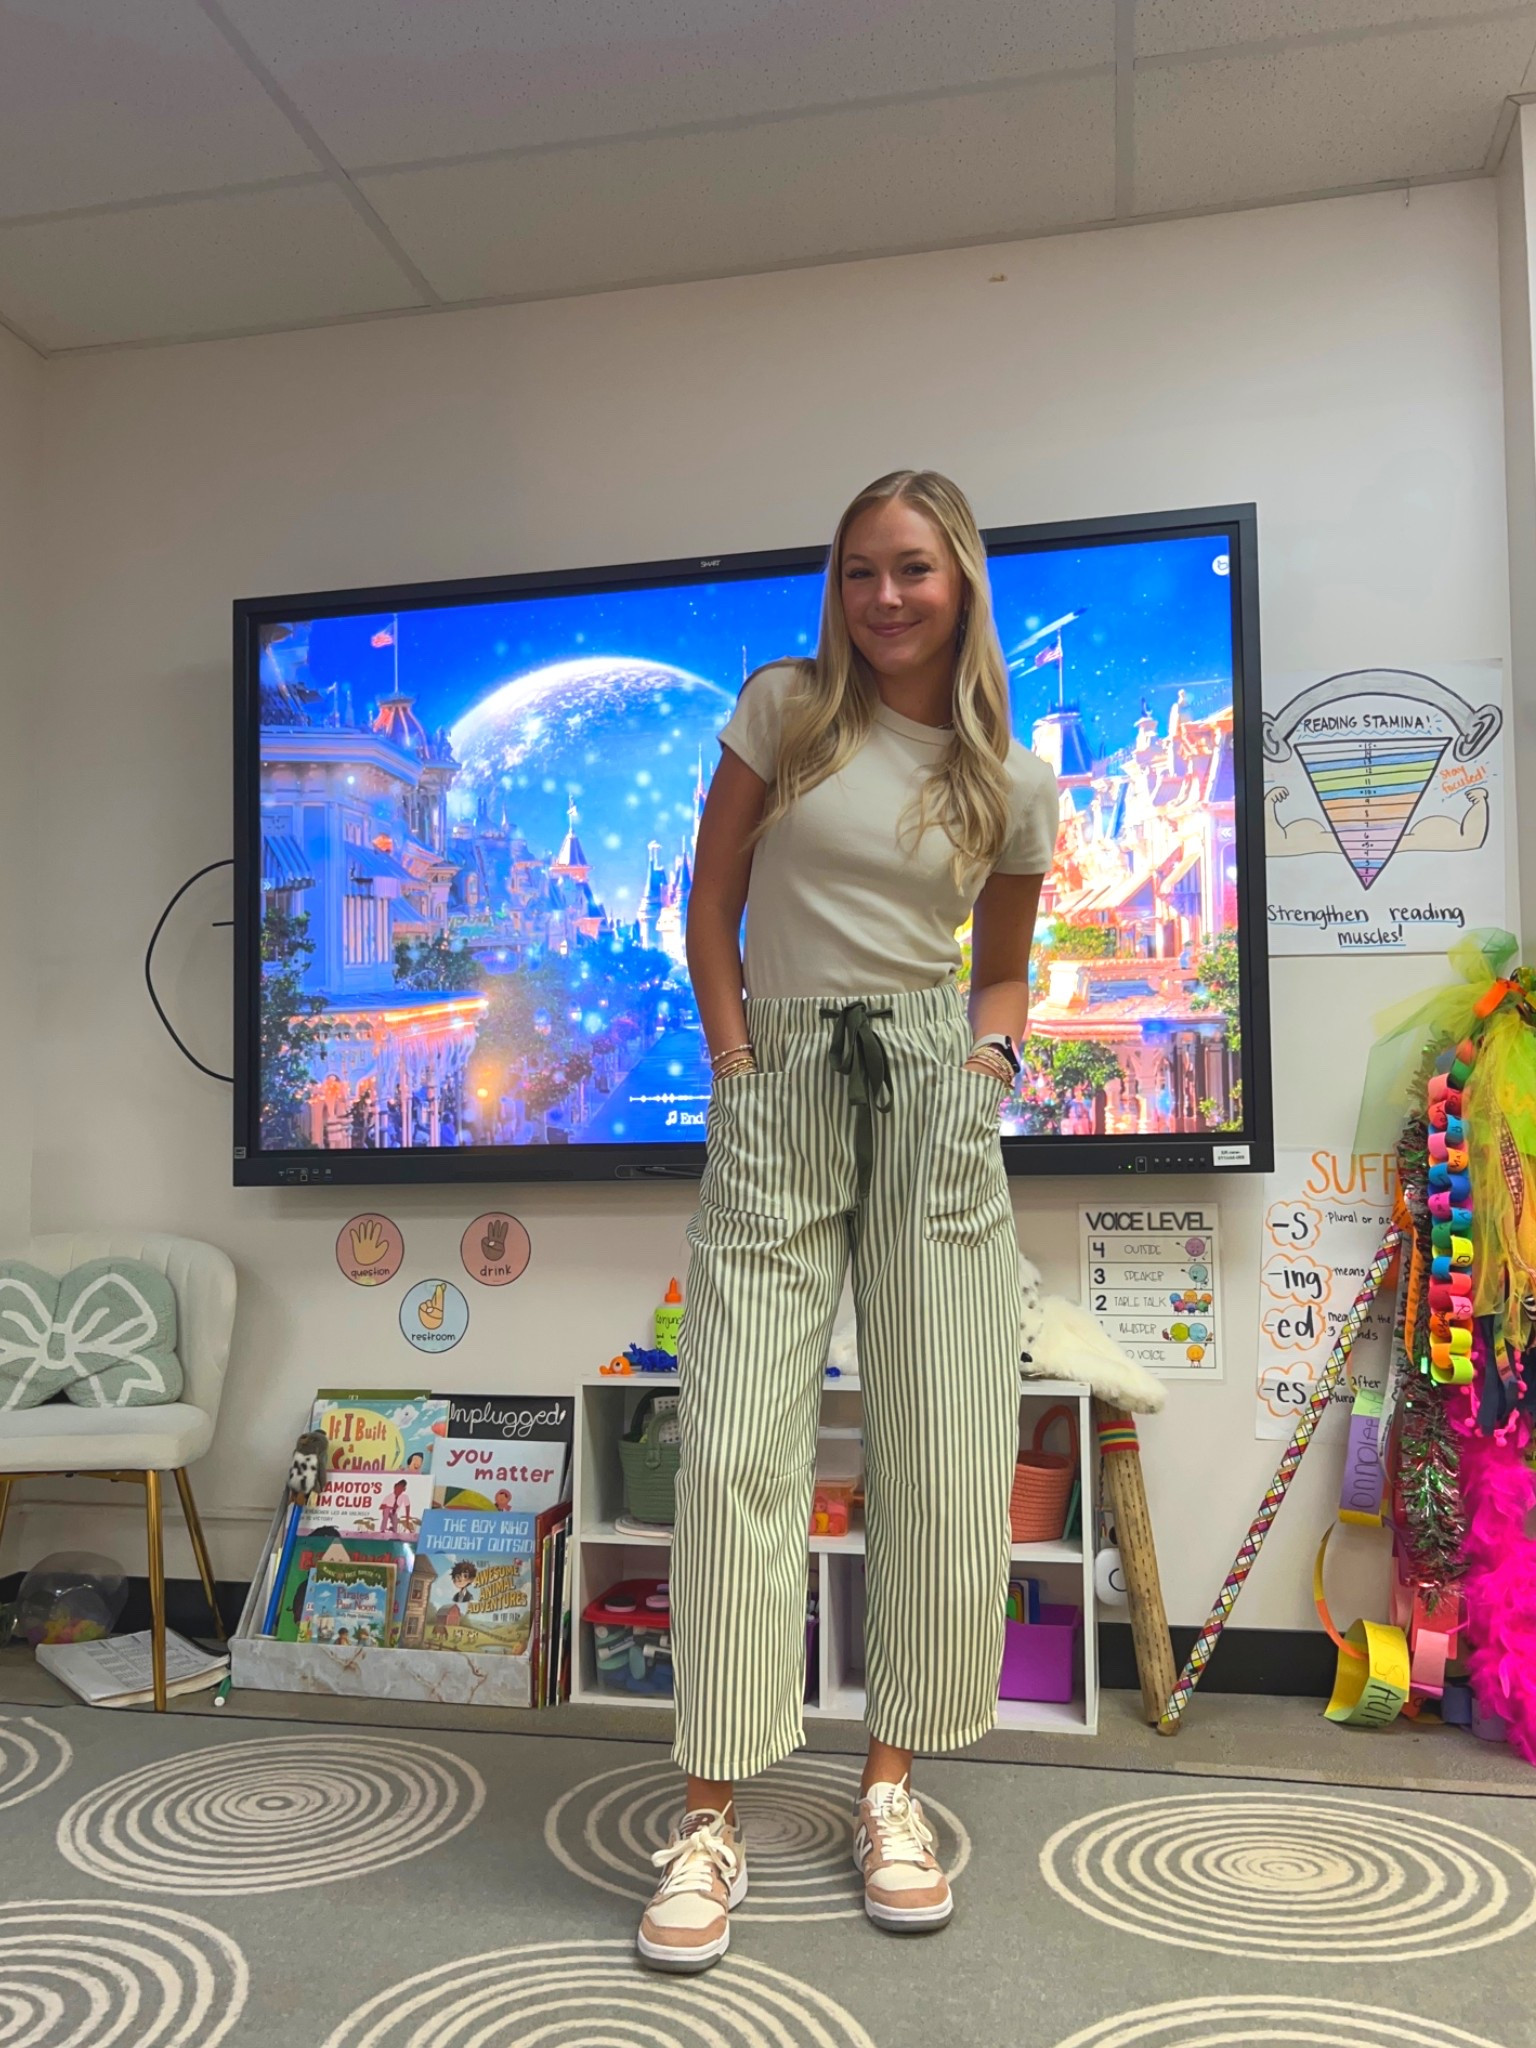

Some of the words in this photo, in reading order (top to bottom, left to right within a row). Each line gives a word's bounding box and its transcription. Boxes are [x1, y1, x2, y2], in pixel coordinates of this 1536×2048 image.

[1303, 715, 1357, 731] READING
[1363, 714, 1431, 729] STAMINA!
[1267, 904, 1369, 930] Strengthen
[1389, 903, 1465, 928] reading
[1338, 925, 1403, 945] muscles!
[1086, 1212, 1143, 1231] VOICE
[1148, 1212, 1213, 1231] LEVEL
[1093, 1242, 1105, 1258] 4
[1124, 1245, 1162, 1255] OUTSIDE
[351, 1267, 390, 1279] question
[480, 1265, 512, 1277] drink
[1094, 1268, 1105, 1284] 3
[1124, 1271, 1164, 1282] SPEAKER
[1334, 1267, 1365, 1277] means
[1096, 1295, 1107, 1311] 2
[1328, 1312, 1349, 1322] mea
[411, 1333, 456, 1342] restroom
[1138, 1350, 1165, 1360] VOICE
[343, 1413, 354, 1442] I
[355, 1417, 387, 1441] Built
[348, 1444, 354, 1453] a
[447, 1449, 493, 1467] you
[475, 1466, 554, 1483] matter
[322, 1481, 382, 1494] AMOTO'S
[316, 1495, 332, 1507] IM
[335, 1495, 372, 1508] CLUB
[443, 1518, 467, 1533] THE
[471, 1520, 496, 1534] BOY
[501, 1521, 529, 1536] WHO
[426, 1534, 485, 1550] THOUGHT
[488, 1537, 535, 1553] OUTSID
[474, 1566, 520, 1588] AWESOME
[480, 1577, 516, 1601] ANIMAL
[467, 1591, 528, 1614] ADVENTURES
